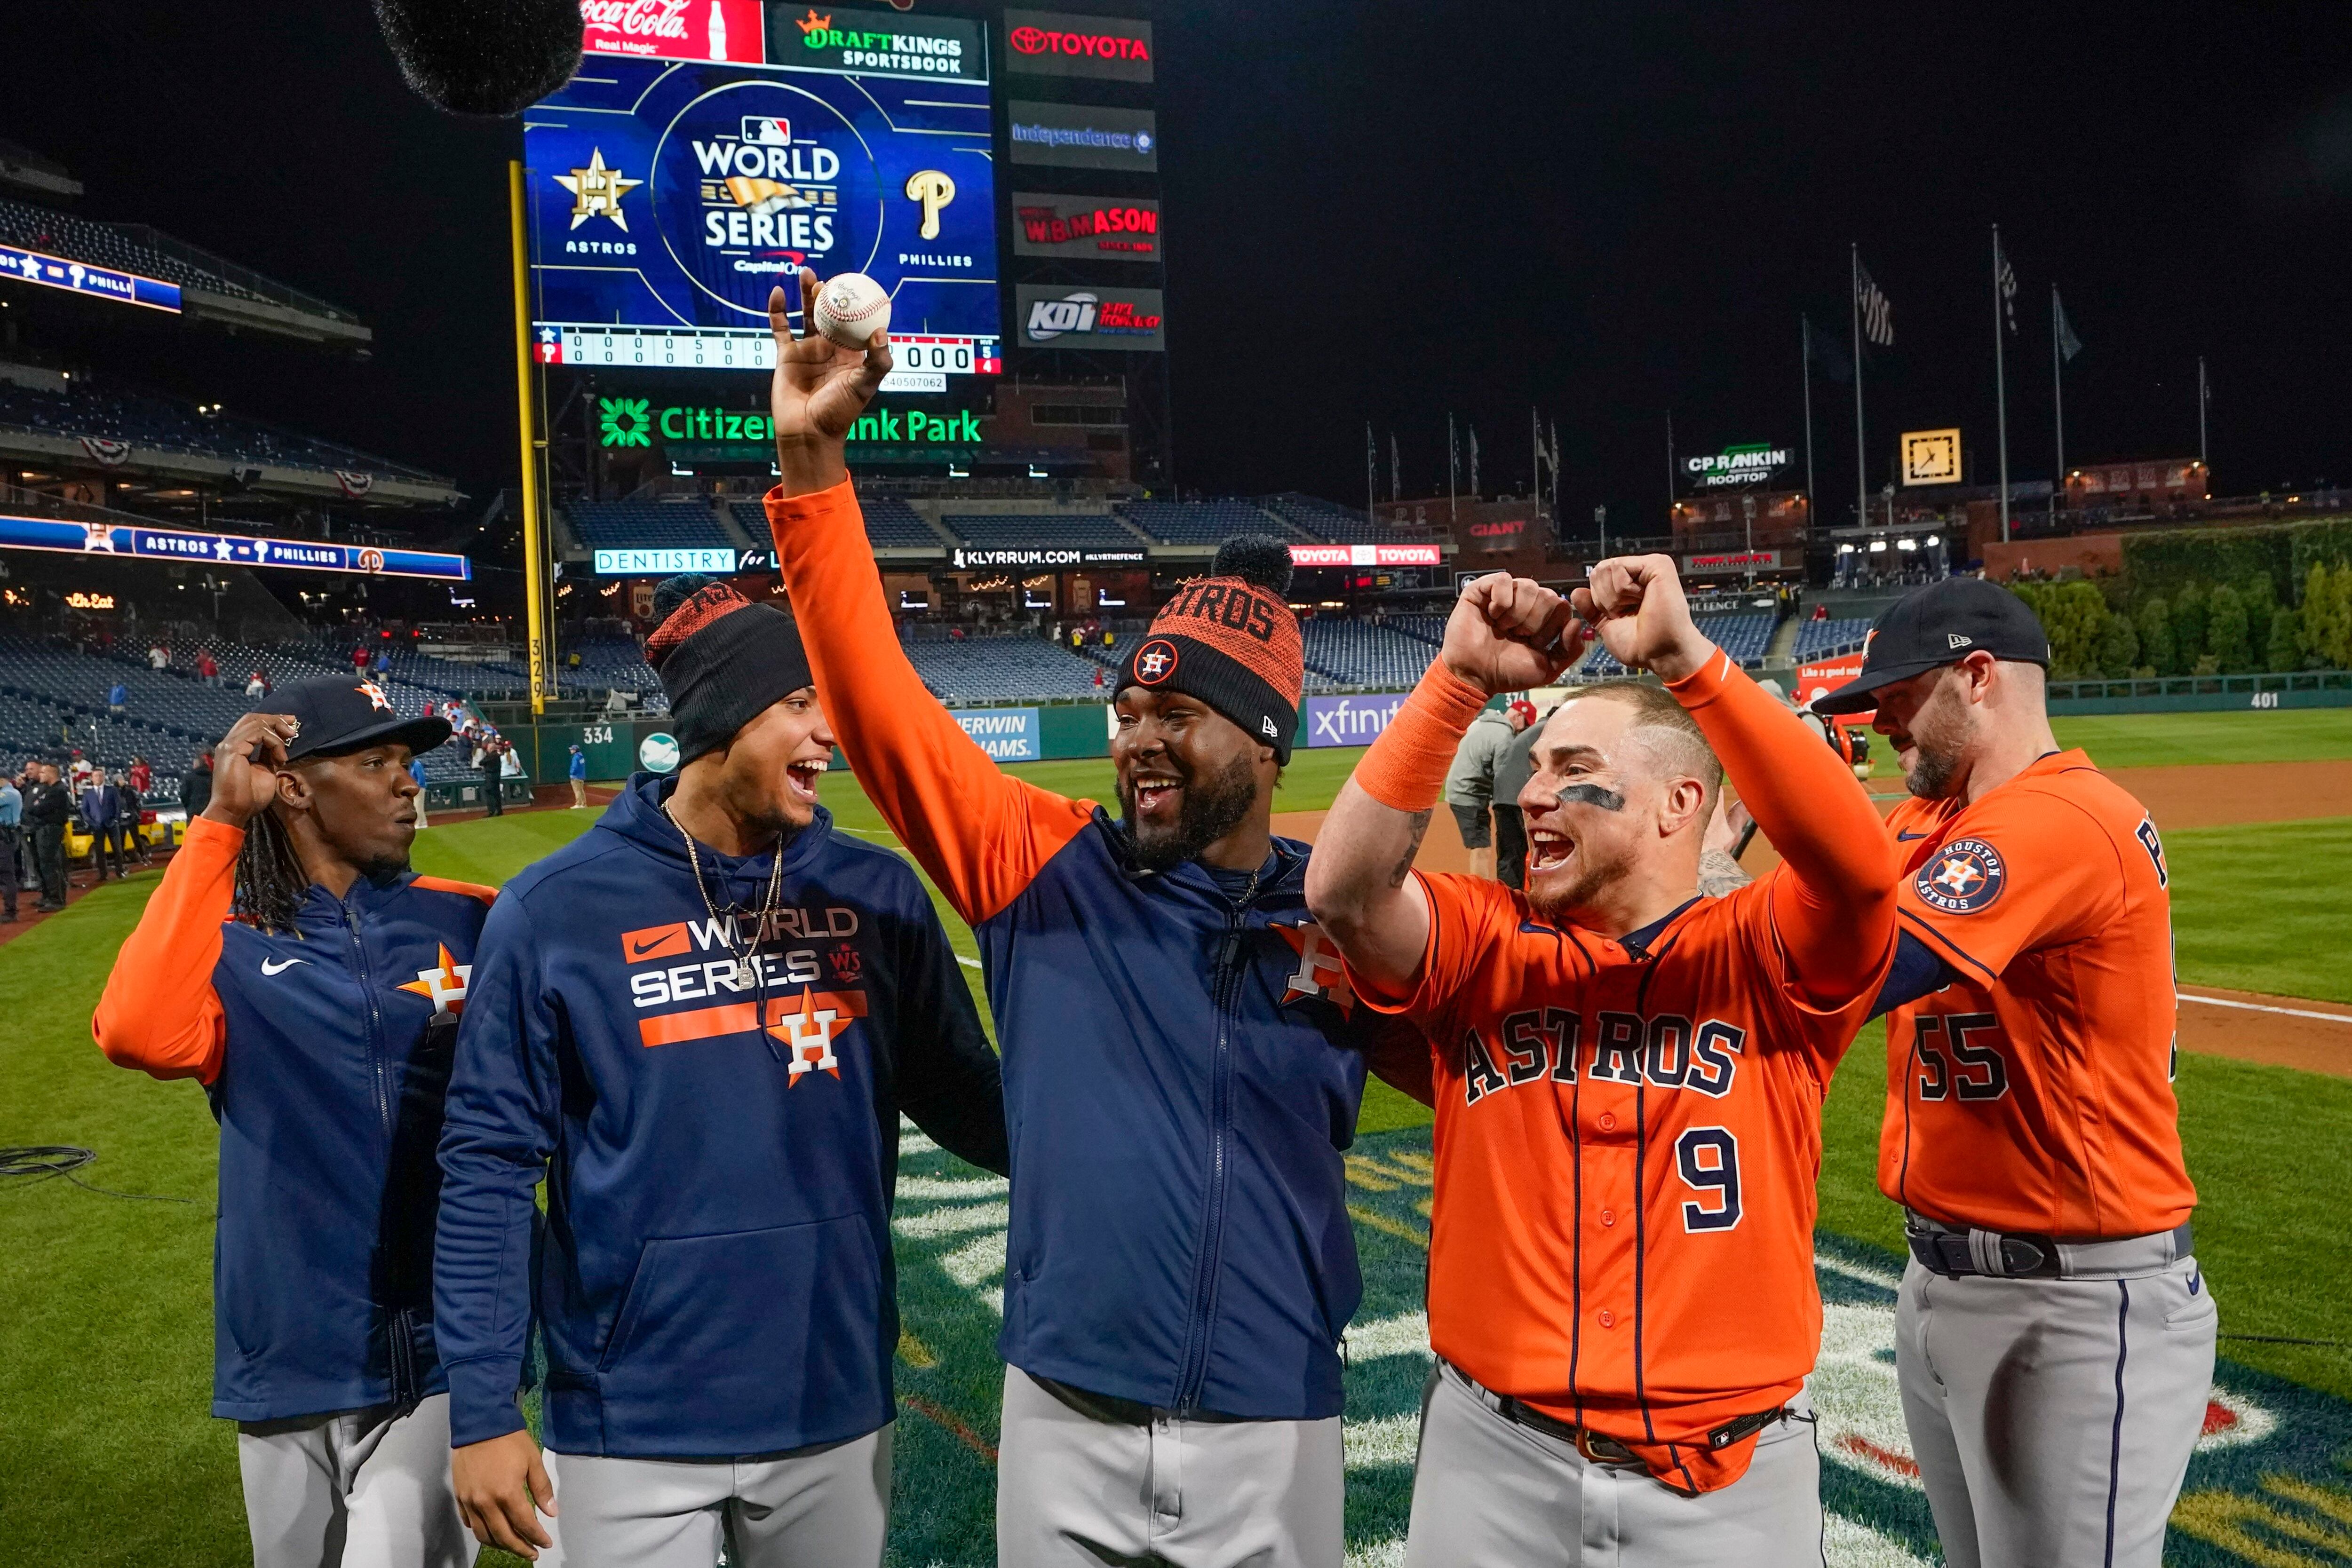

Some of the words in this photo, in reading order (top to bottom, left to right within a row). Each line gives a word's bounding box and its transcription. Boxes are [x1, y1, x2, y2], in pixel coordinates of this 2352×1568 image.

[596, 39, 620, 51] Real
[623, 40, 657, 55] Magic
[1046, 32, 1149, 61] TOYOTA
[843, 51, 961, 73] SPORTSBOOK
[1012, 123, 1131, 149] Independence
[692, 141, 840, 181] WORLD
[705, 211, 834, 252] SERIES
[565, 240, 637, 255] ASTROS
[899, 253, 972, 267] PHILLIES
[574, 335, 582, 347] 0
[605, 336, 612, 348] 0
[635, 337, 642, 348] 0
[666, 338, 673, 349] 0
[695, 339, 702, 350] 5
[724, 340, 732, 351] 0
[755, 341, 762, 351] 0
[907, 347, 921, 368] 0
[931, 348, 945, 368] 0
[955, 348, 969, 369] 0
[982, 345, 992, 359] 5
[575, 350, 582, 361] 0
[605, 351, 612, 362] 0
[636, 352, 643, 363] 0
[666, 353, 674, 364] 0
[696, 353, 703, 364] 0
[725, 354, 732, 365] 0
[755, 355, 762, 366] 0
[982, 359, 992, 373] 4
[907, 409, 982, 442] Park
[1688, 456, 1715, 471] CP
[1716, 450, 1786, 470] RANKIN
[1707, 472, 1768, 486] ROOFTOP
[1469, 521, 1525, 537] GIANT
[146, 537, 209, 554] ASTROS
[274, 546, 337, 564] PHILLIES
[599, 552, 728, 569] DENTISTRY
[739, 549, 765, 570] for
[968, 551, 1081, 564] KLYRRUM.COM
[1293, 549, 1349, 562] TOYOTA
[1378, 549, 1436, 562] TOYOTA
[1157, 584, 1275, 642] STROS
[2251, 692, 2278, 708] 401
[583, 726, 613, 744] 334
[1944, 841, 2001, 877] HOUSTON
[1918, 880, 1969, 909] ASTROS
[687, 908, 858, 950] WORLD
[630, 949, 822, 1008] SERIES
[1464, 1006, 1747, 1108] ASTROS
[1914, 1012, 2009, 1101] 55
[1675, 1125, 1744, 1234] 9
